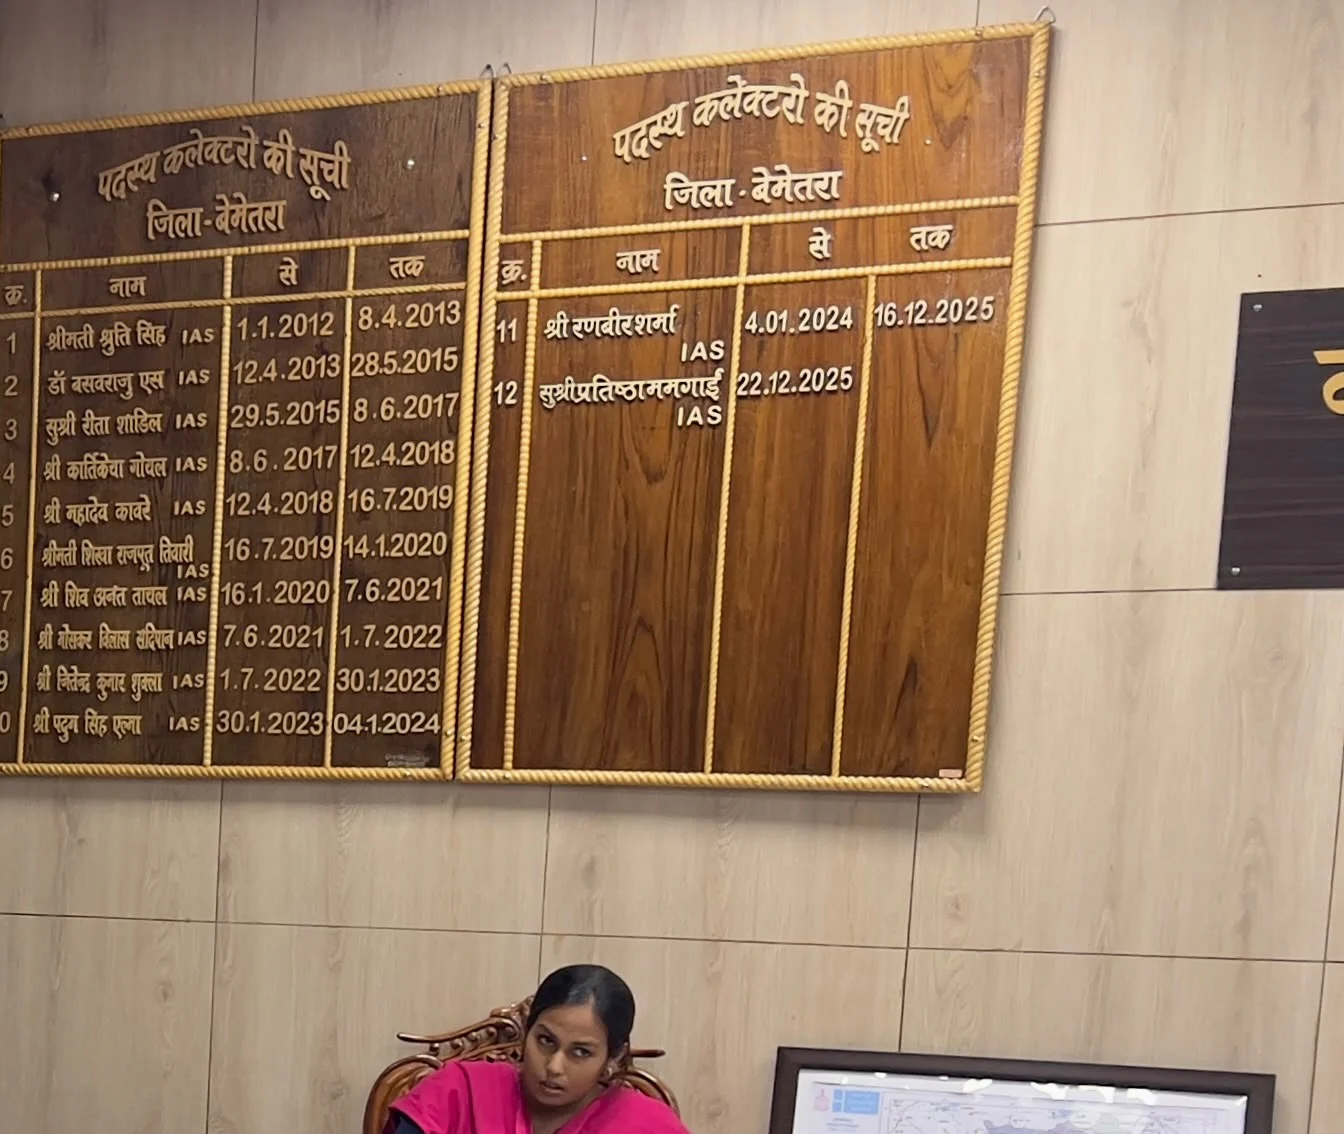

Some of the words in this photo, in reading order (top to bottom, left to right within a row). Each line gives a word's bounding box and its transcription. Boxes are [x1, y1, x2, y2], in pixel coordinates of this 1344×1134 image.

[612, 101, 689, 162] पदस्थ
[814, 80, 853, 138] की
[855, 96, 910, 153] सूची
[98, 151, 160, 201] पदस्थ
[263, 128, 296, 178] की
[299, 140, 352, 201] सूची
[616, 248, 661, 274] नाम
[808, 227, 831, 260] से
[909, 224, 953, 252] तक
[109, 275, 146, 298] नाम
[279, 256, 299, 286] से
[389, 254, 426, 280] तक
[6, 332, 17, 354] 1
[46, 323, 94, 350] श्रीमती
[99, 321, 132, 356] श्रुति
[136, 320, 166, 347] सिंह
[182, 328, 215, 344] IAS
[237, 312, 335, 340] 1.1.2012
[358, 301, 461, 331] 8.4.2013
[496, 318, 517, 343] 11
[544, 311, 568, 339] श्री
[744, 305, 854, 335] 4.01.2024
[874, 296, 995, 328] 16.12.2025
[4, 375, 18, 397] 2
[47, 370, 67, 395] डॉ
[138, 370, 165, 394] एस
[178, 369, 210, 385] IAS
[233, 354, 341, 384] 12.4.2013
[351, 347, 459, 377] 28.5.2015
[681, 340, 725, 362] IAS
[494, 381, 518, 405] 12
[736, 366, 853, 396] 22.12.2025
[4, 419, 17, 441] 3
[45, 410, 76, 445] सुश्री
[82, 409, 111, 436] रीता
[175, 413, 208, 429] IAS
[230, 400, 340, 428] 29.5.2015
[353, 392, 459, 422] 8.6.2017
[677, 406, 722, 427] IAS
[2, 462, 15, 484] 4
[43, 454, 61, 480] श्री
[129, 451, 168, 478] गोयल
[175, 457, 208, 472] IAS
[229, 445, 338, 473] 8.6.2017
[350, 440, 455, 468] 12.4.2018
[1, 505, 14, 527] 5
[43, 497, 61, 524] श्री
[66, 495, 108, 527] महादेव
[115, 494, 151, 521] कावरे
[173, 501, 206, 515] IAS
[225, 490, 334, 517] 12.4.2018
[347, 485, 453, 513] 16.7.2019
[0, 548, 13, 570] 6
[41, 539, 77, 567] श्रीमती
[81, 539, 113, 566] शिखा
[159, 534, 194, 564] तिवारी
[177, 563, 209, 579] IAS
[224, 535, 334, 561] 16.7.2019
[343, 531, 447, 559] 14.1.2020
[1, 590, 13, 612] 7
[40, 580, 59, 607] श्री
[64, 580, 90, 607] शिव
[131, 586, 168, 607] तायल
[177, 587, 207, 602] IAS
[220, 580, 330, 606] 16.1.2020
[345, 576, 443, 602] 7.6.2021
[37, 623, 53, 650] श्री
[177, 630, 207, 646] IAS
[223, 624, 324, 648] 7.6.2021
[341, 624, 443, 649] 1.7.2022
[36, 664, 51, 691] श्री
[96, 673, 126, 701] कुमार
[173, 674, 204, 689] IAS
[220, 668, 321, 692] 1.7.2022
[336, 668, 441, 692] 30.1.2023
[33, 706, 50, 733] श्री
[84, 708, 108, 737] सिंह
[169, 716, 200, 731] IAS
[216, 711, 324, 735] 30.1.2023
[333, 712, 441, 735] 04.1.2024
